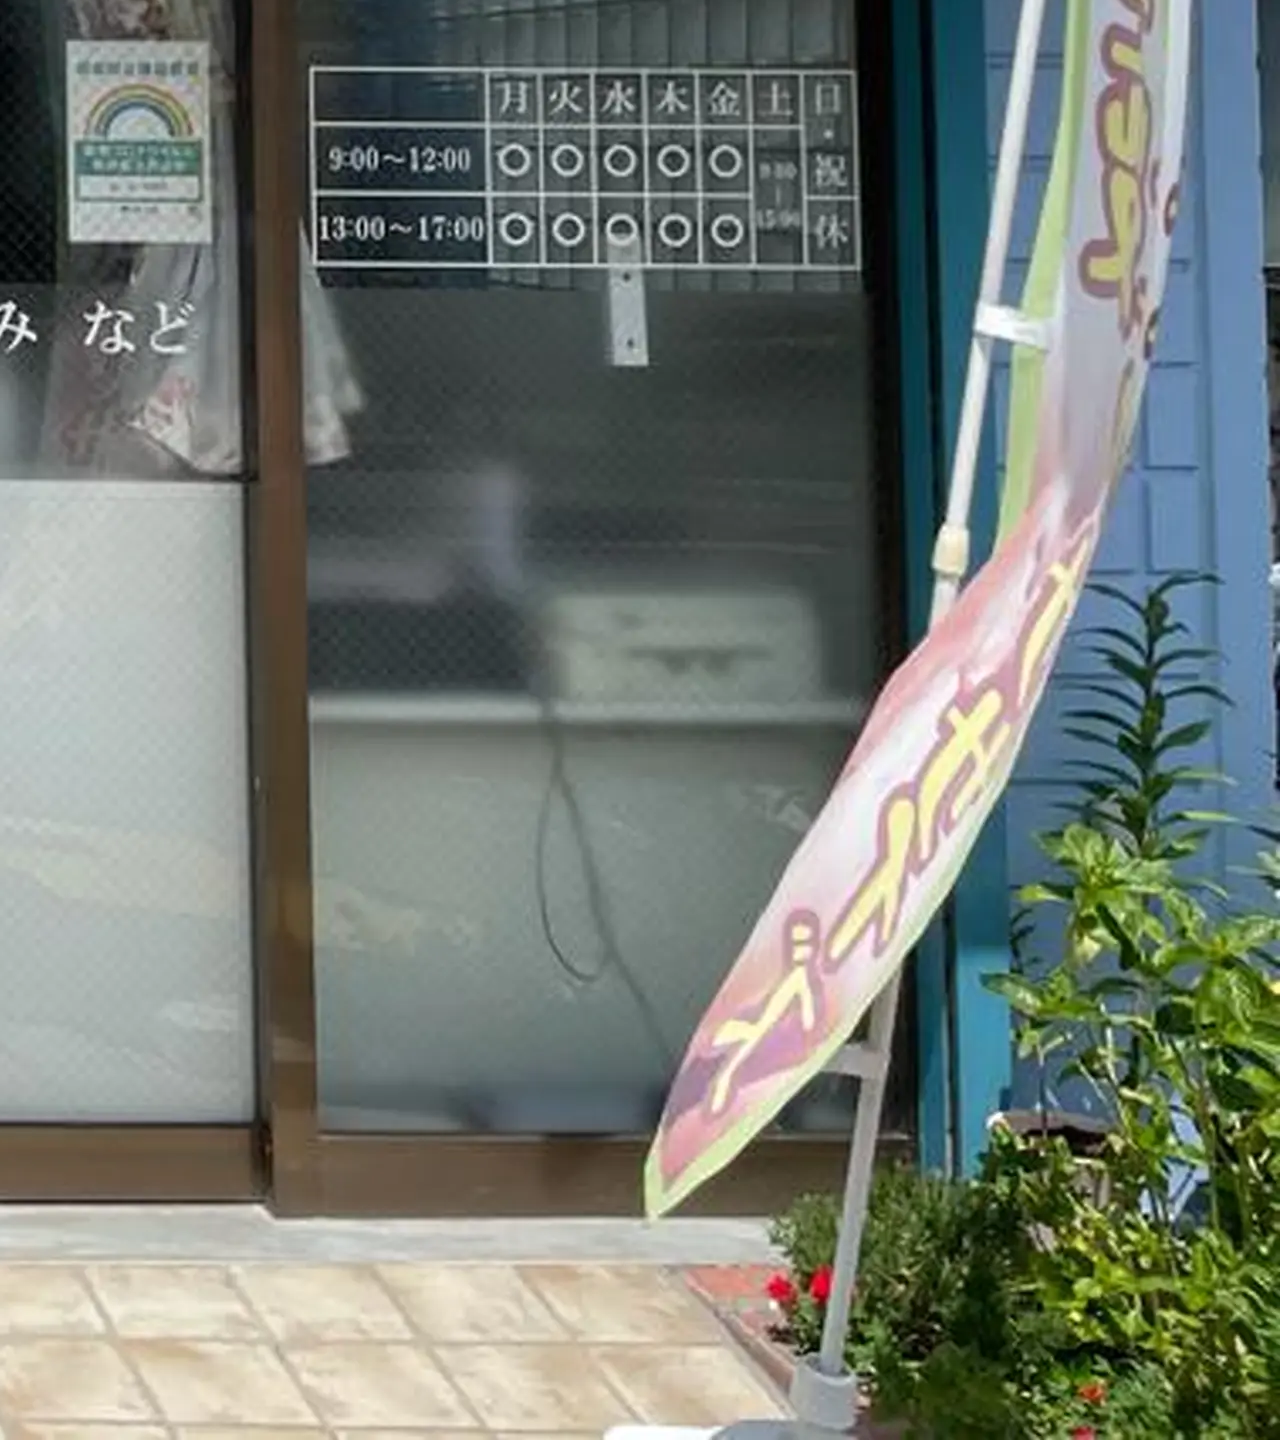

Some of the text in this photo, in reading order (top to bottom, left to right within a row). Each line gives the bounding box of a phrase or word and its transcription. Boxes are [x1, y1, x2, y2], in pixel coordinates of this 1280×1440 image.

[498, 80, 793, 117] 月 火 水 木 金 土
[815, 213, 850, 250] 休
[83, 299, 198, 355] など
